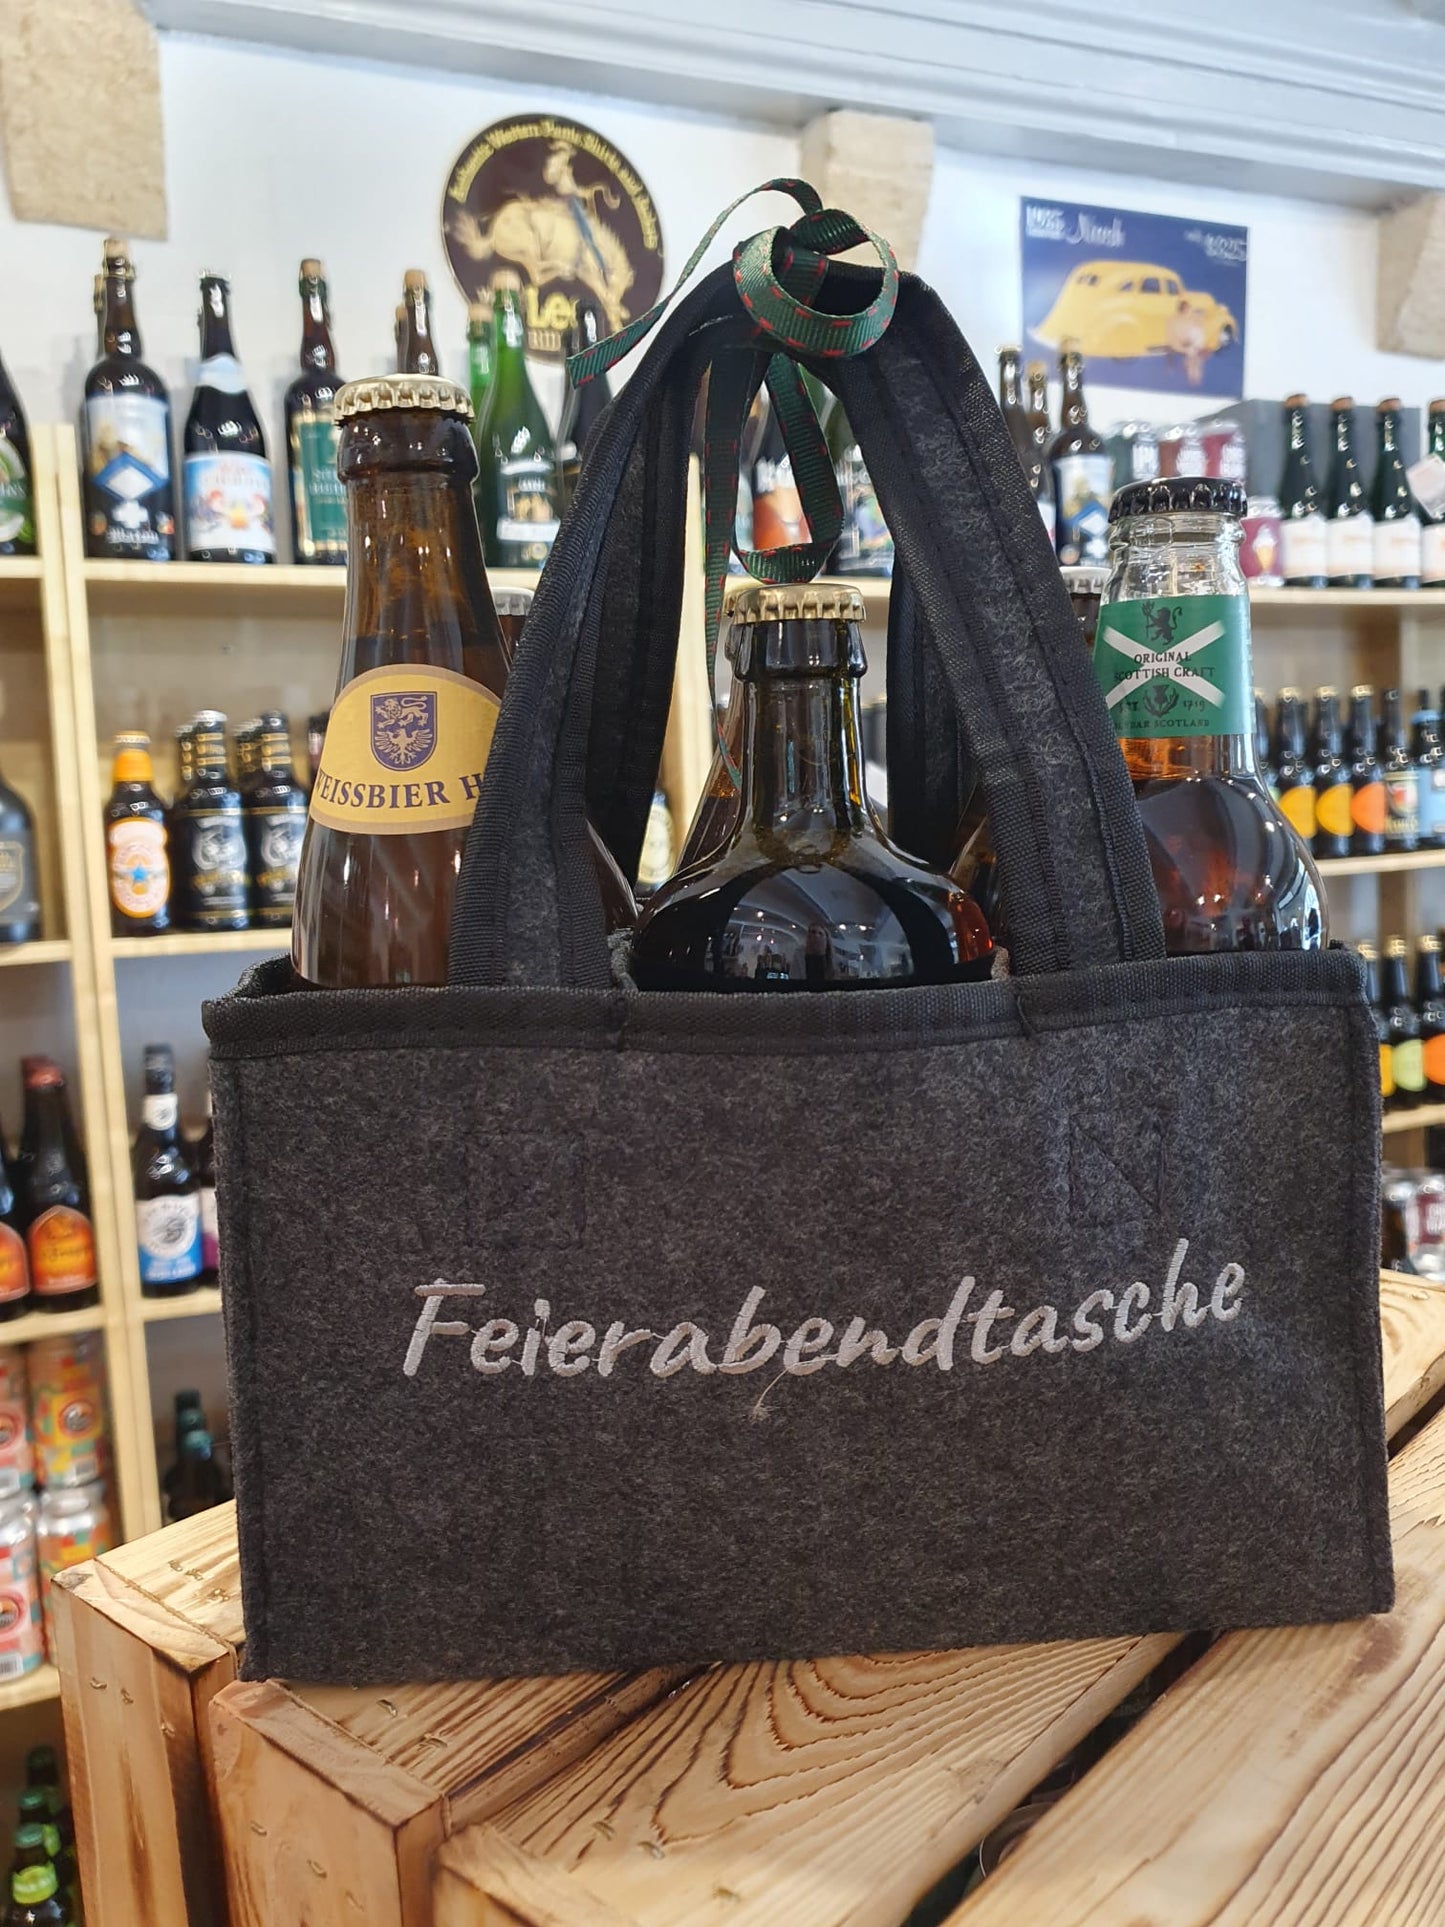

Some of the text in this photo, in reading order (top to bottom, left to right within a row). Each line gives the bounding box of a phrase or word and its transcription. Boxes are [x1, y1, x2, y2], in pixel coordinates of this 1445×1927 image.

[1134, 651, 1192, 664] ORIGINAL
[1114, 666, 1216, 682] SCOTTISH CRAFT
[1154, 719, 1210, 730] SCOTLAND
[402, 1238, 1247, 1377] Feierabendtasche
